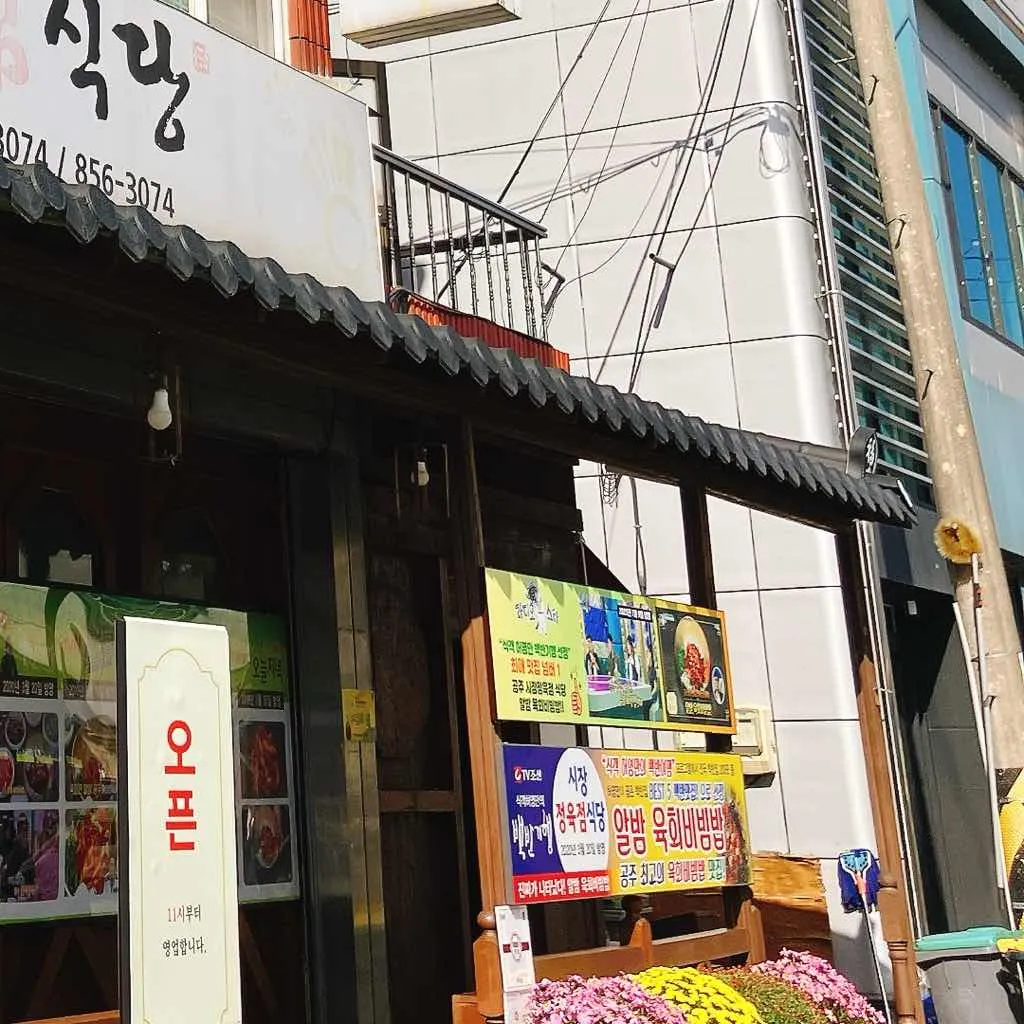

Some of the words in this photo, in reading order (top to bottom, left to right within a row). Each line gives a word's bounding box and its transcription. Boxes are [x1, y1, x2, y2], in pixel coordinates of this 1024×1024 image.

[75, 153, 176, 219] 856-3074
[164, 719, 198, 852] 오픈
[567, 765, 589, 798] 시장
[555, 800, 606, 834] 정육점식당
[612, 806, 646, 857] 알밤
[652, 805, 725, 854] 육회비빔밥
[511, 809, 553, 861] 백반기행
[619, 864, 638, 890] 공주
[167, 905, 202, 924] 11시부터
[162, 937, 208, 958] 영업합니다.
